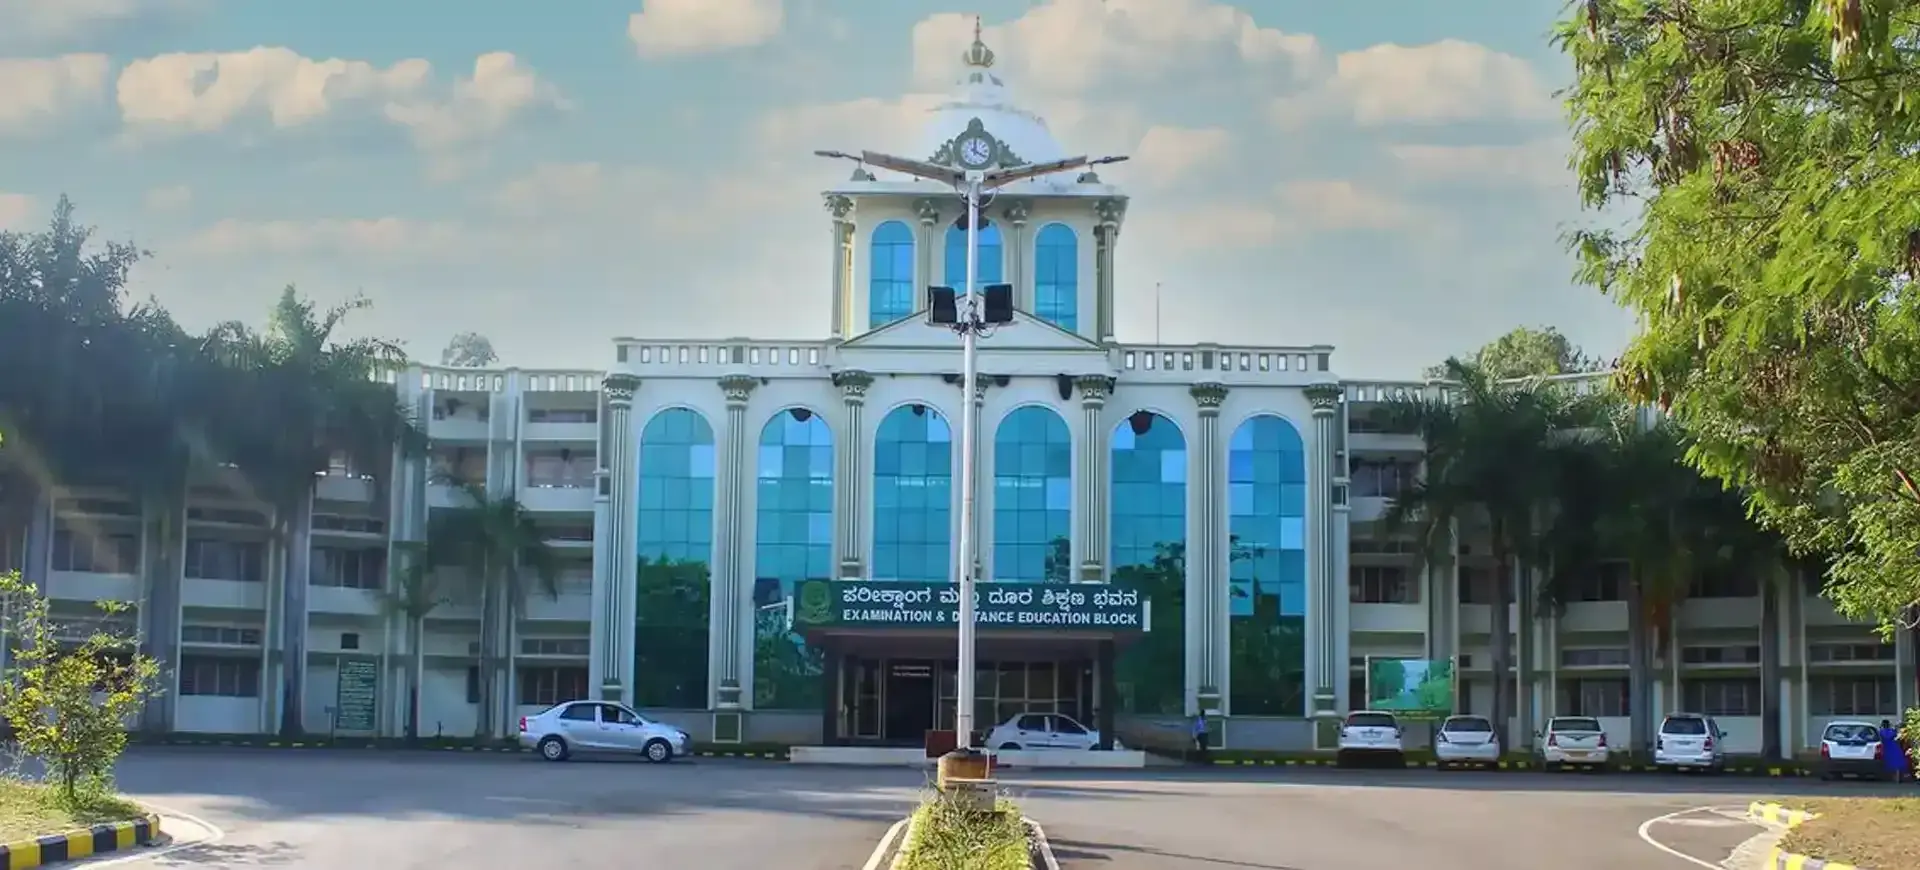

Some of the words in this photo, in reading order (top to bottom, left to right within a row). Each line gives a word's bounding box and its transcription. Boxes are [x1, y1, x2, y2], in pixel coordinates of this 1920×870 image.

[842, 586, 932, 610] ಪರೀಕ್ಷಾಂಗ
[988, 587, 1034, 604] ದೂರ
[1041, 588, 1085, 612] ಶಿಕ್ಷಣ
[1093, 588, 1138, 609] ಭವನ
[842, 609, 932, 622] EXAMINATION
[935, 610, 945, 622] &
[952, 610, 1015, 623] DTANCE
[1018, 612, 1091, 624] EDUCATION
[1093, 612, 1138, 624] BLOCK
